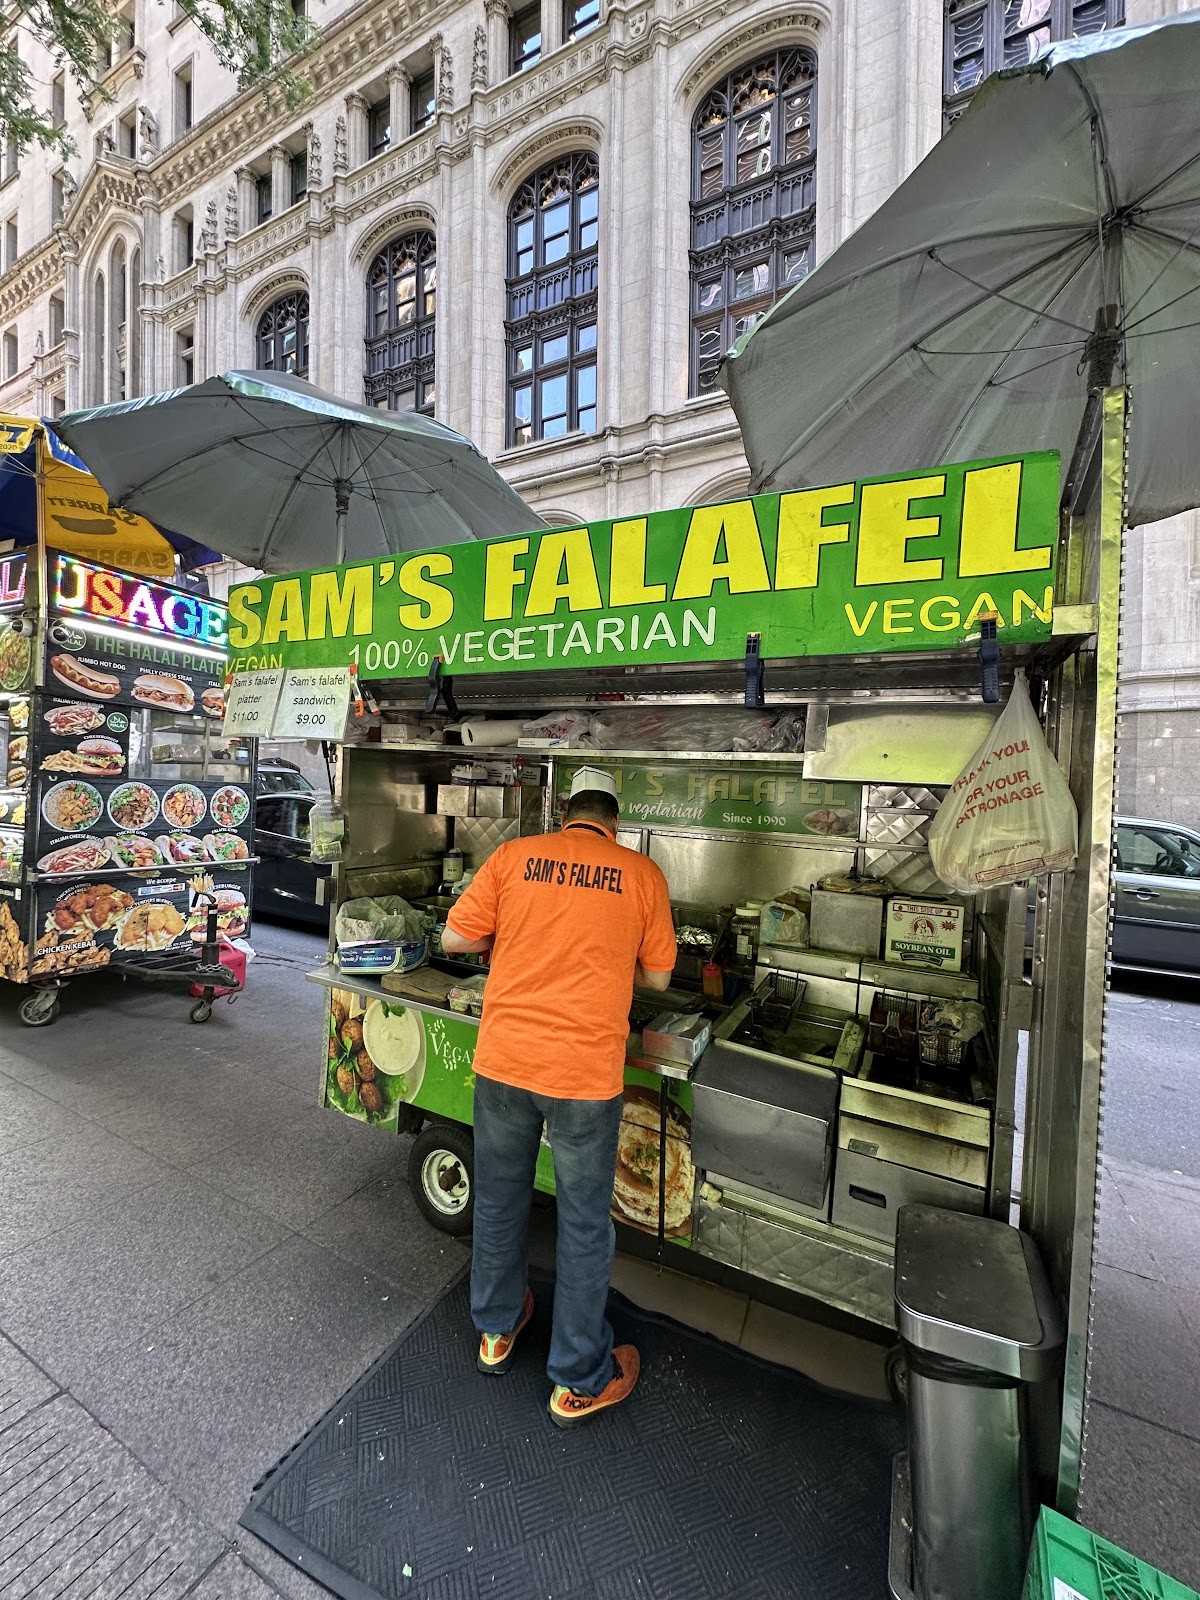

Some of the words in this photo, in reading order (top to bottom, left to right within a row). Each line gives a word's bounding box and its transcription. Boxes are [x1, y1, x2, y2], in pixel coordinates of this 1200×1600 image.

[228, 553, 454, 649] SAM'S
[483, 461, 1052, 622] FALAFEL
[844, 585, 1055, 638] VEGAN
[348, 637, 429, 672] 100%
[438, 606, 717, 667] VEGETARIAN
[93, 633, 126, 656] THE
[129, 643, 179, 668] HALAL
[76, 656, 98, 667] JUMBO
[99, 661, 112, 669] HOT
[113, 663, 126, 671] DOG
[139, 667, 158, 675] PHILLY
[159, 671, 177, 679] CHEESE
[177, 674, 192, 682] STEAK
[233, 677, 253, 688] Sam's
[254, 674, 279, 687] falafel
[290, 676, 316, 686] Sam's
[319, 674, 346, 686] falafel
[237, 694, 262, 706] platter
[293, 695, 336, 705] sandwich
[232, 711, 259, 722] $11.00
[296, 713, 326, 725] $9.00
[951, 759, 991, 793] THAK
[992, 740, 1031, 761] YOU!
[687, 773, 846, 807] FALAFEL
[965, 787, 985, 805] OR
[985, 769, 1031, 792] YOUR
[628, 800, 706, 820] vegetarian
[956, 782, 1045, 829] PATRONAGE
[722, 812, 753, 824] Since
[757, 815, 787, 826] 1990
[49, 835, 69, 846] ITALIAN
[524, 857, 567, 885] SAM'S
[569, 862, 623, 894] FALAFEL
[37, 943, 71, 955] CHICKEN
[72, 939, 96, 950] KEBAB
[895, 942, 935, 953] SOYBEAN
[936, 947, 951, 955] OIL
[430, 1031, 476, 1064] VEGA
[563, 1396, 593, 1410] HOKA
